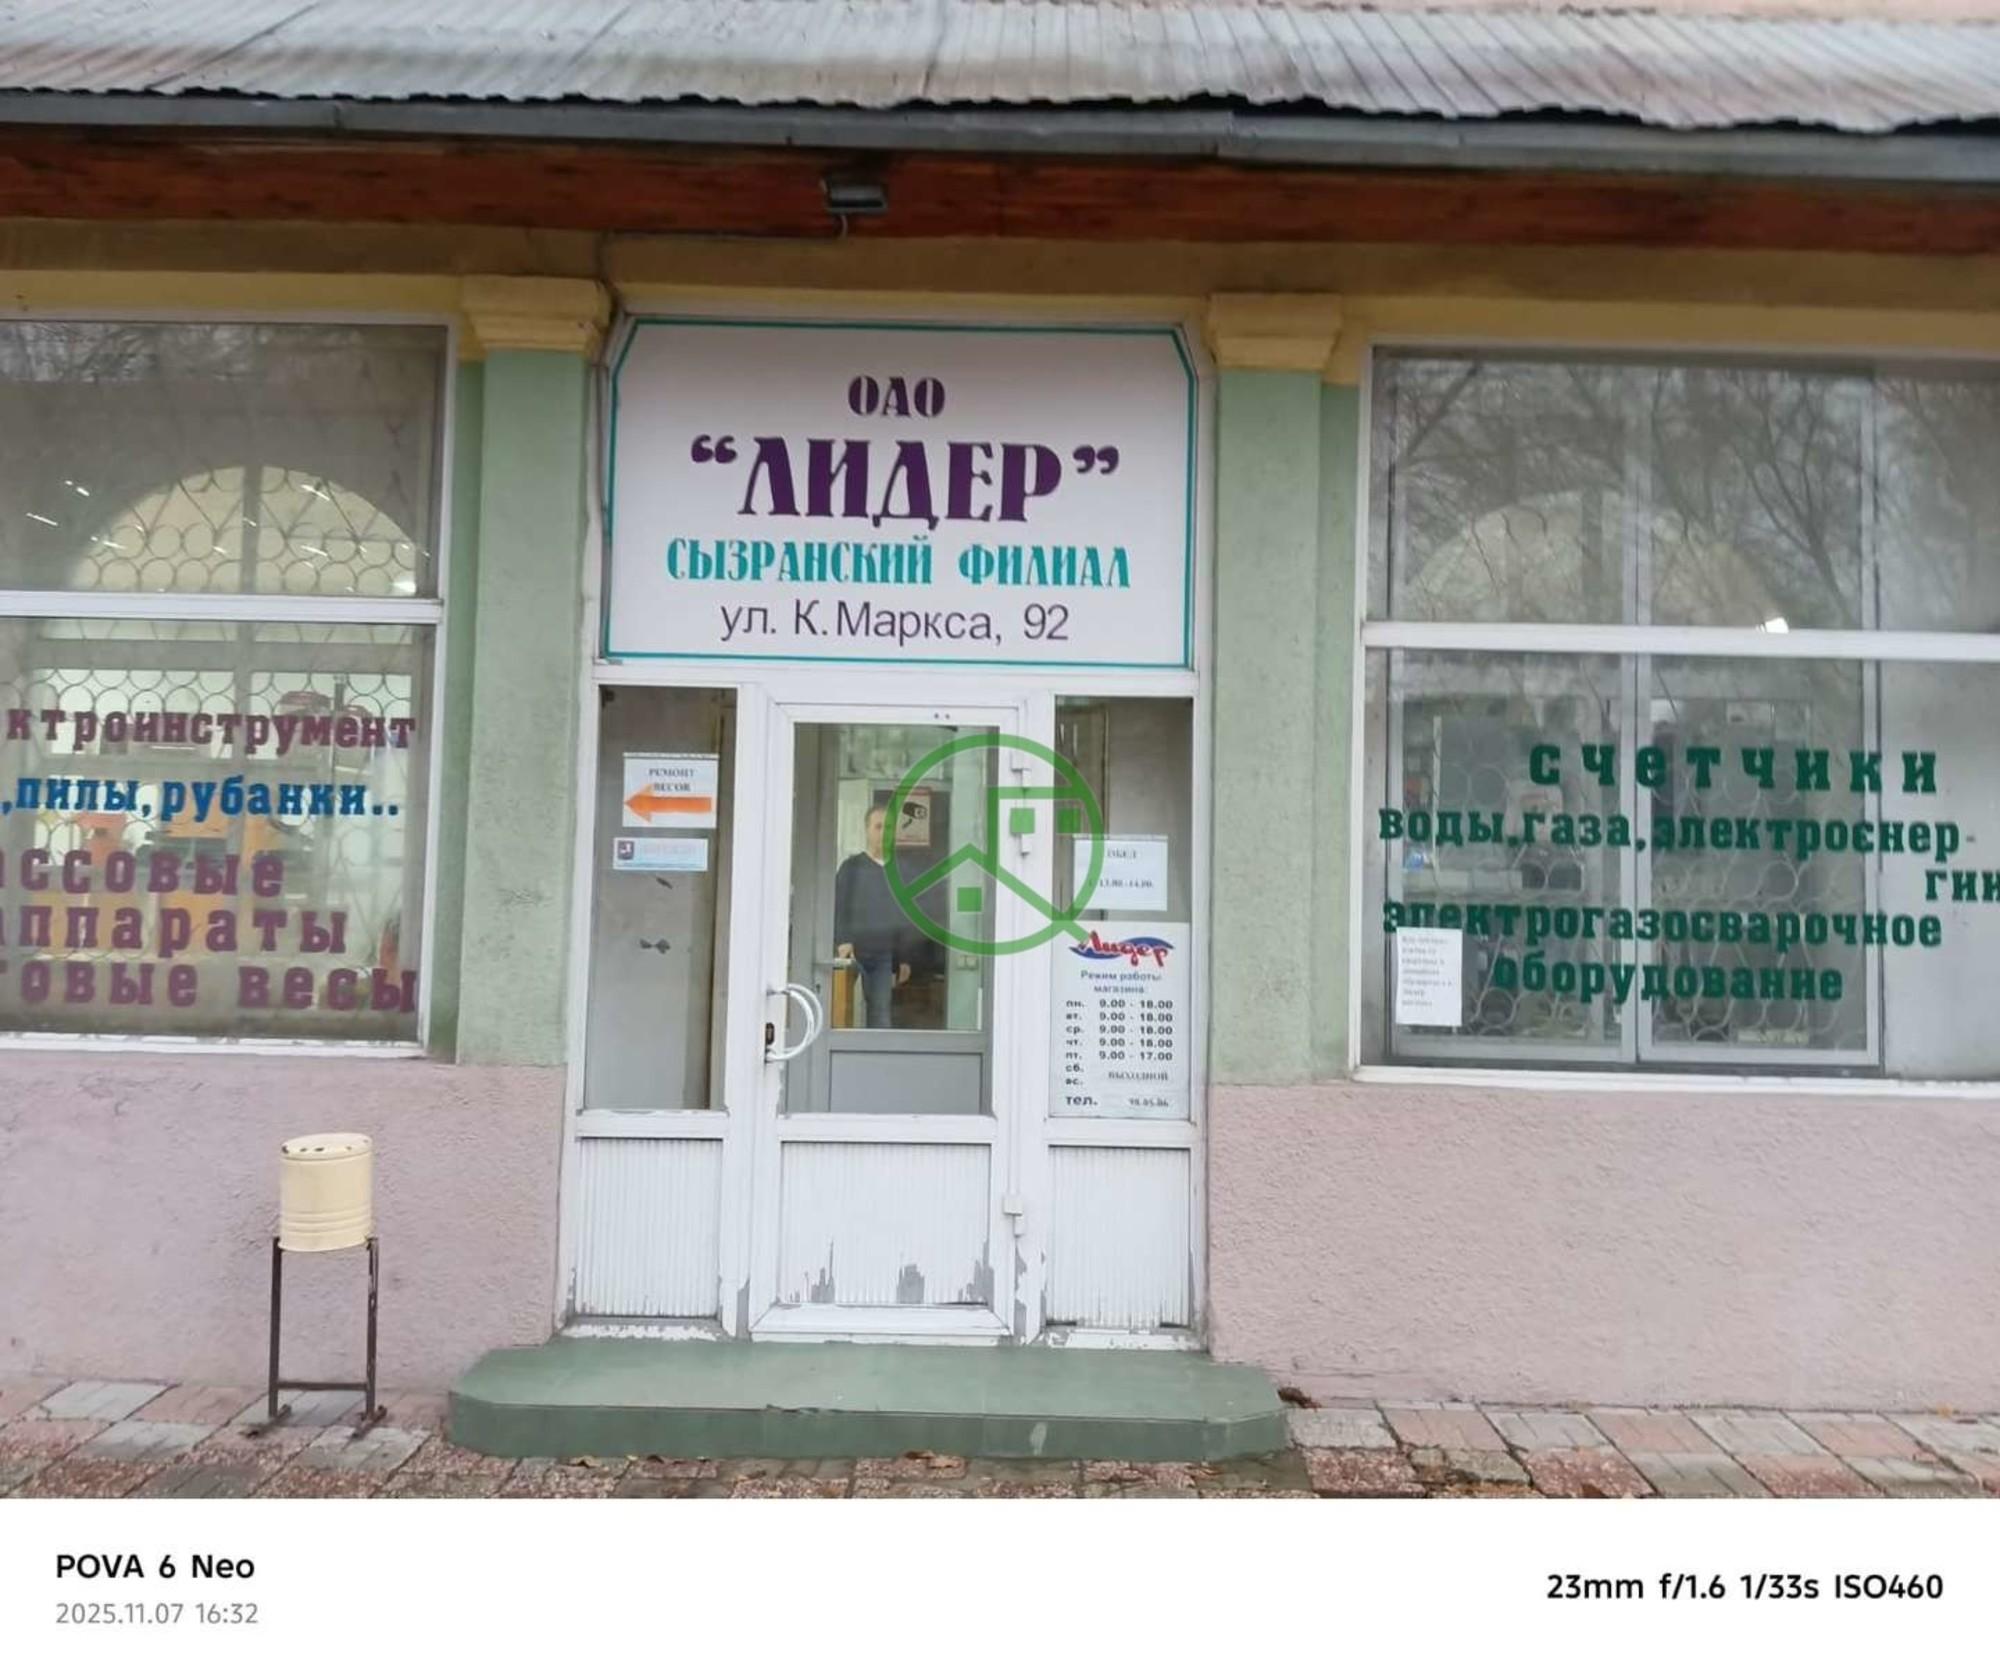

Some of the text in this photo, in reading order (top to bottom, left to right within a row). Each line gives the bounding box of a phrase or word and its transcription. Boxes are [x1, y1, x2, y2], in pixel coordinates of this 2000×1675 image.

[848, 375, 946, 418] ОАО
[667, 534, 1131, 589] СЫЗРАНСКИЙ ФИЛИАЛ
[721, 604, 777, 641] ул.
[1023, 603, 1069, 640] 92
[1529, 743, 1937, 793] счетчики
[0, 847, 284, 897] ссовые
[0, 904, 347, 958] ппараты
[0, 957, 418, 1012] овые весы
[1080, 969, 1117, 980] Режим
[1494, 949, 1843, 1005] оборудование
[1099, 998, 1126, 1008] 9.00
[1140, 999, 1173, 1009] 18.00
[1099, 1011, 1126, 1021] 9.00
[1140, 1012, 1173, 1022] 18.00
[1099, 1024, 1126, 1034] 9.00
[1140, 1025, 1173, 1035] 18.00
[1099, 1037, 1126, 1047] 9.00
[1140, 1038, 1173, 1048] 18.00
[1099, 1050, 1126, 1060] 9.00
[1140, 1051, 1173, 1061] 17.00
[1065, 1096, 1099, 1106] тел.
